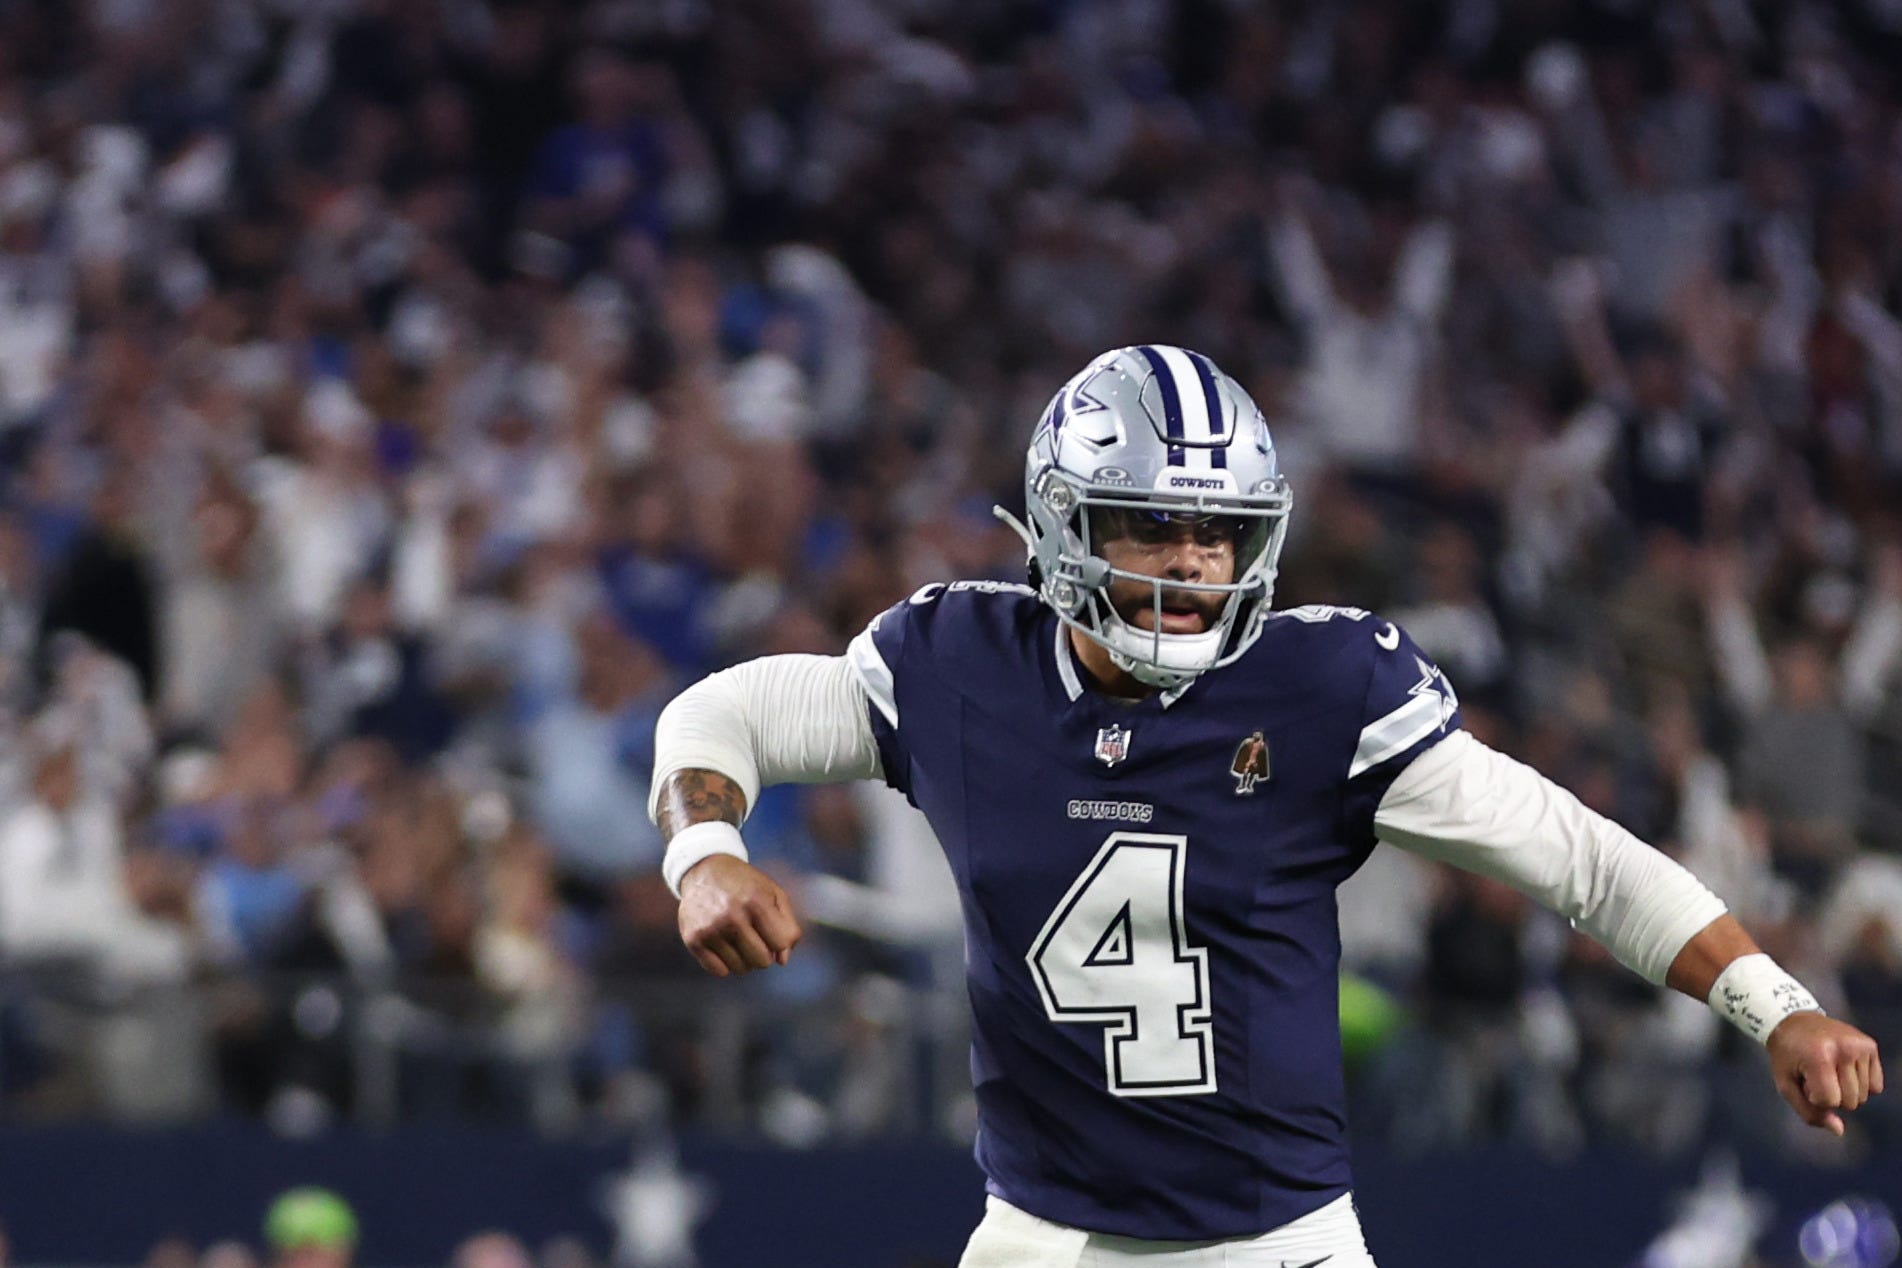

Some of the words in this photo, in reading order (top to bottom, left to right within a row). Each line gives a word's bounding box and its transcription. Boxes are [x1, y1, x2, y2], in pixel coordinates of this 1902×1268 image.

[1170, 476, 1225, 490] COWBOYS
[1067, 799, 1154, 823] COWBOYS
[1025, 831, 1218, 1097] 4
